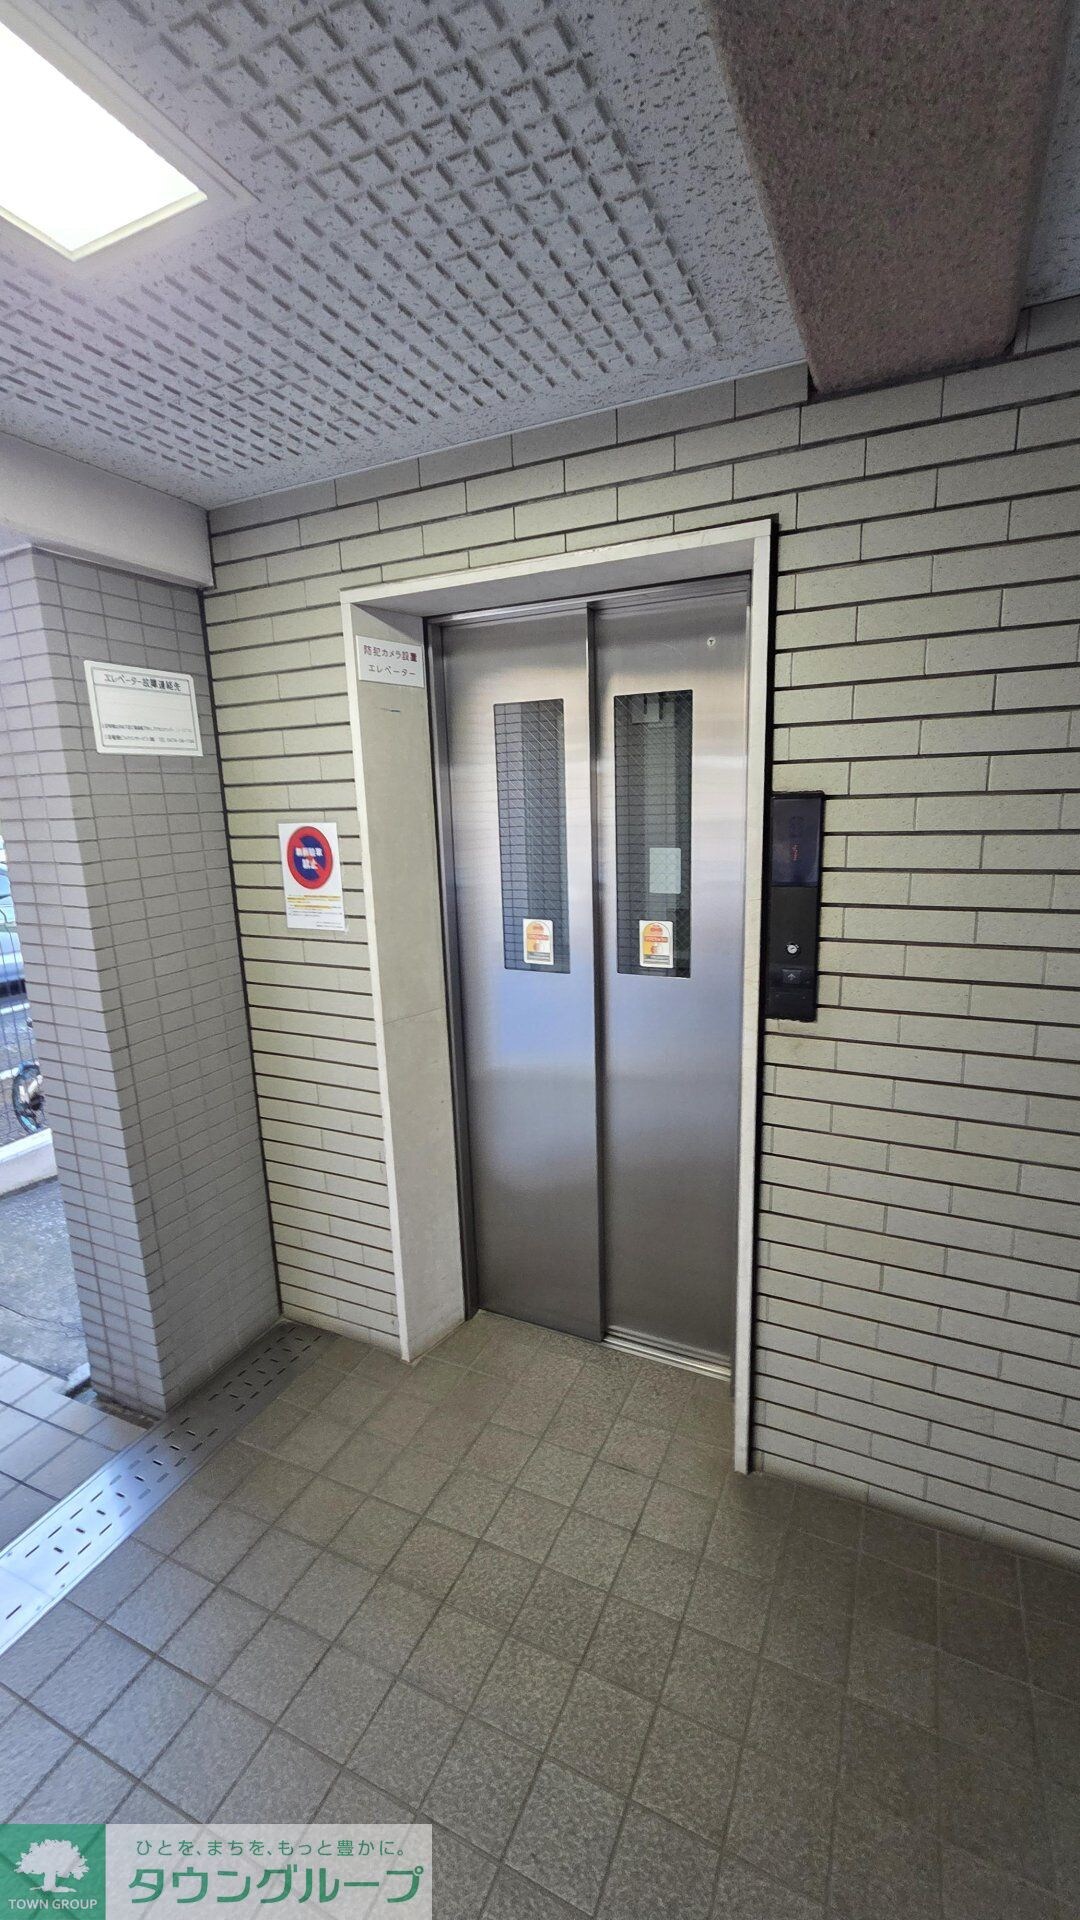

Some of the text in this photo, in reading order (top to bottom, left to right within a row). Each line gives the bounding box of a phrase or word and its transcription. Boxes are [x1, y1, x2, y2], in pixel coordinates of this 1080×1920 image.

[368, 664, 416, 677] エレベーター
